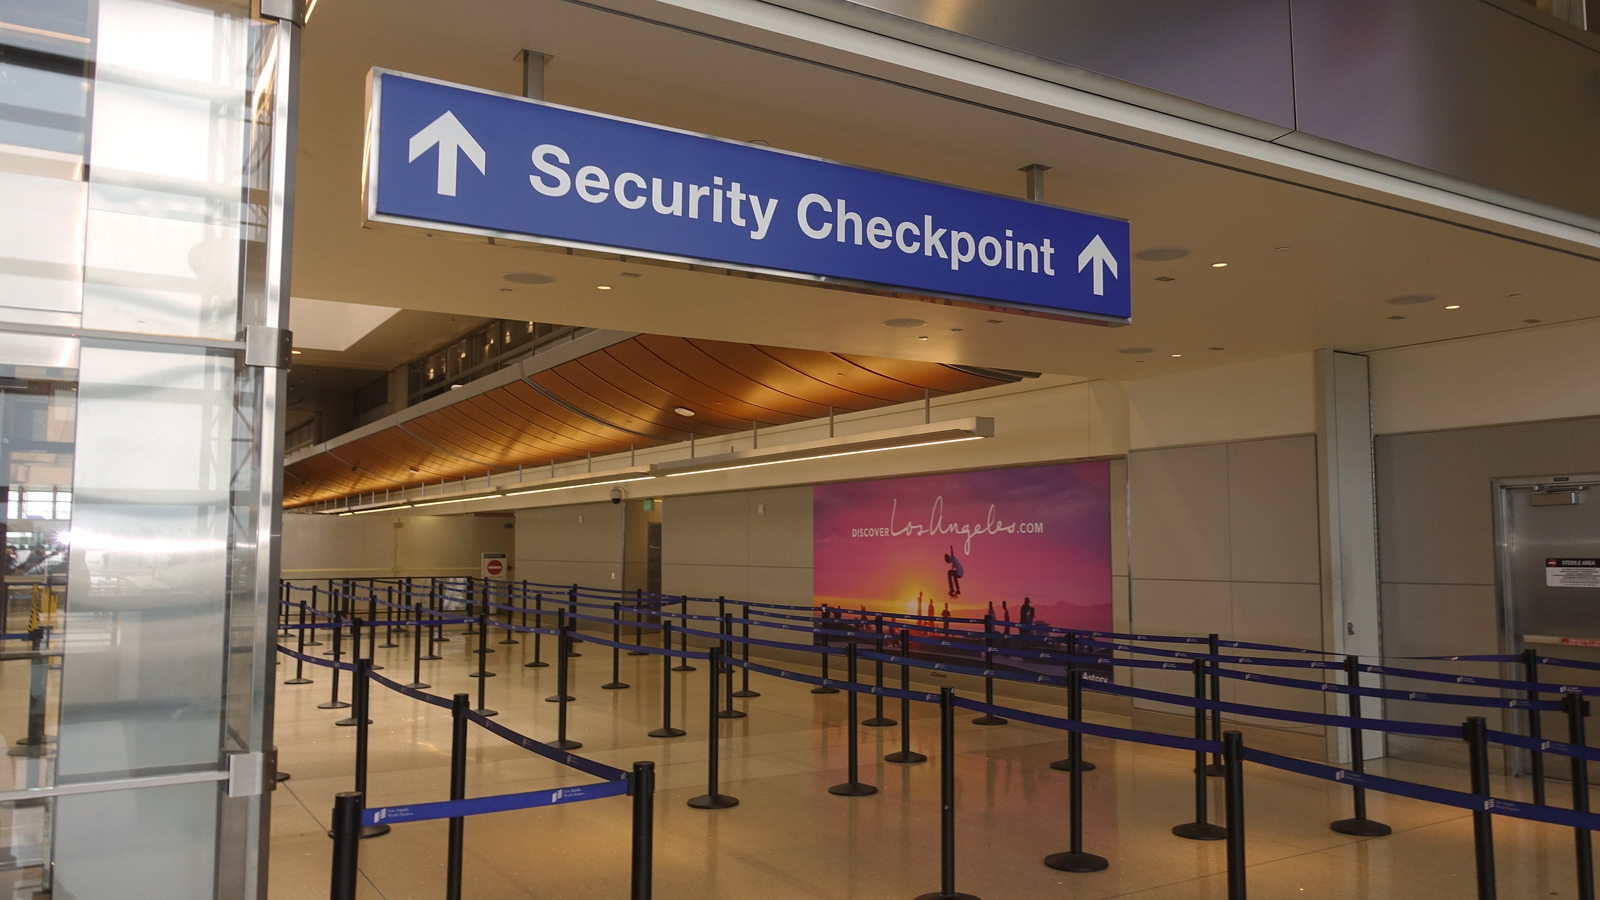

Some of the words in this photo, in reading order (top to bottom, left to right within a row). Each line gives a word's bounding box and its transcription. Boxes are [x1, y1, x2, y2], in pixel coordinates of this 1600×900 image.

[529, 144, 778, 240] Security
[797, 193, 1055, 276] Checkpoint
[852, 527, 890, 537] DISCOVER
